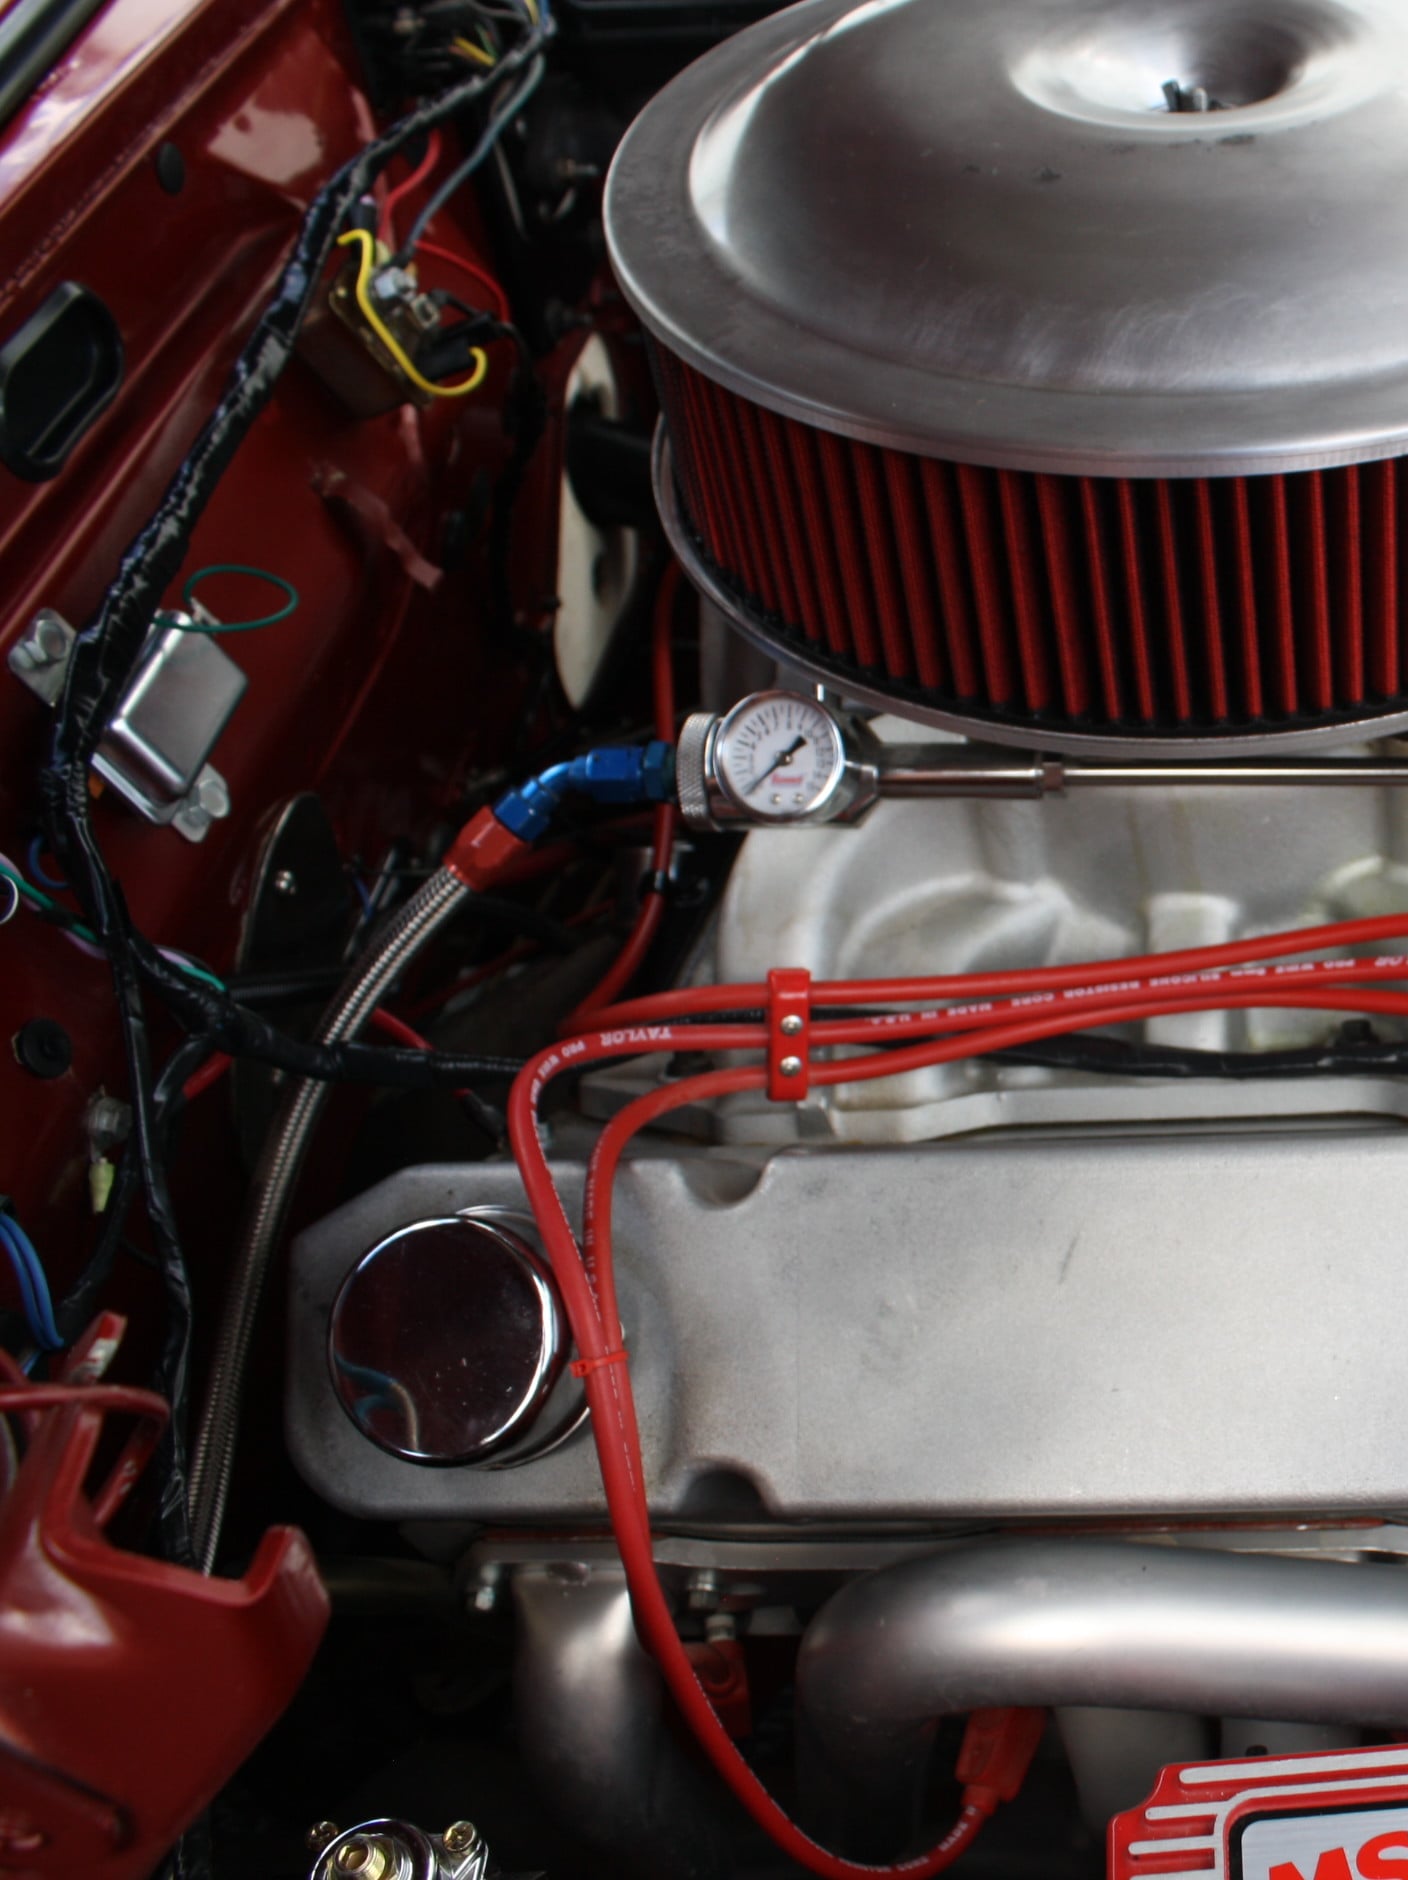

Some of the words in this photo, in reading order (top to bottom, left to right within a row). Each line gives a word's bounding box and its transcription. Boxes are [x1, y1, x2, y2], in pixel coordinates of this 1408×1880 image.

[1010, 992, 1055, 1008] CORE
[920, 1010, 938, 1021] IN
[947, 1002, 993, 1017] MADE
[600, 1026, 672, 1047] TAYLOR
[561, 1040, 587, 1058] PRO
